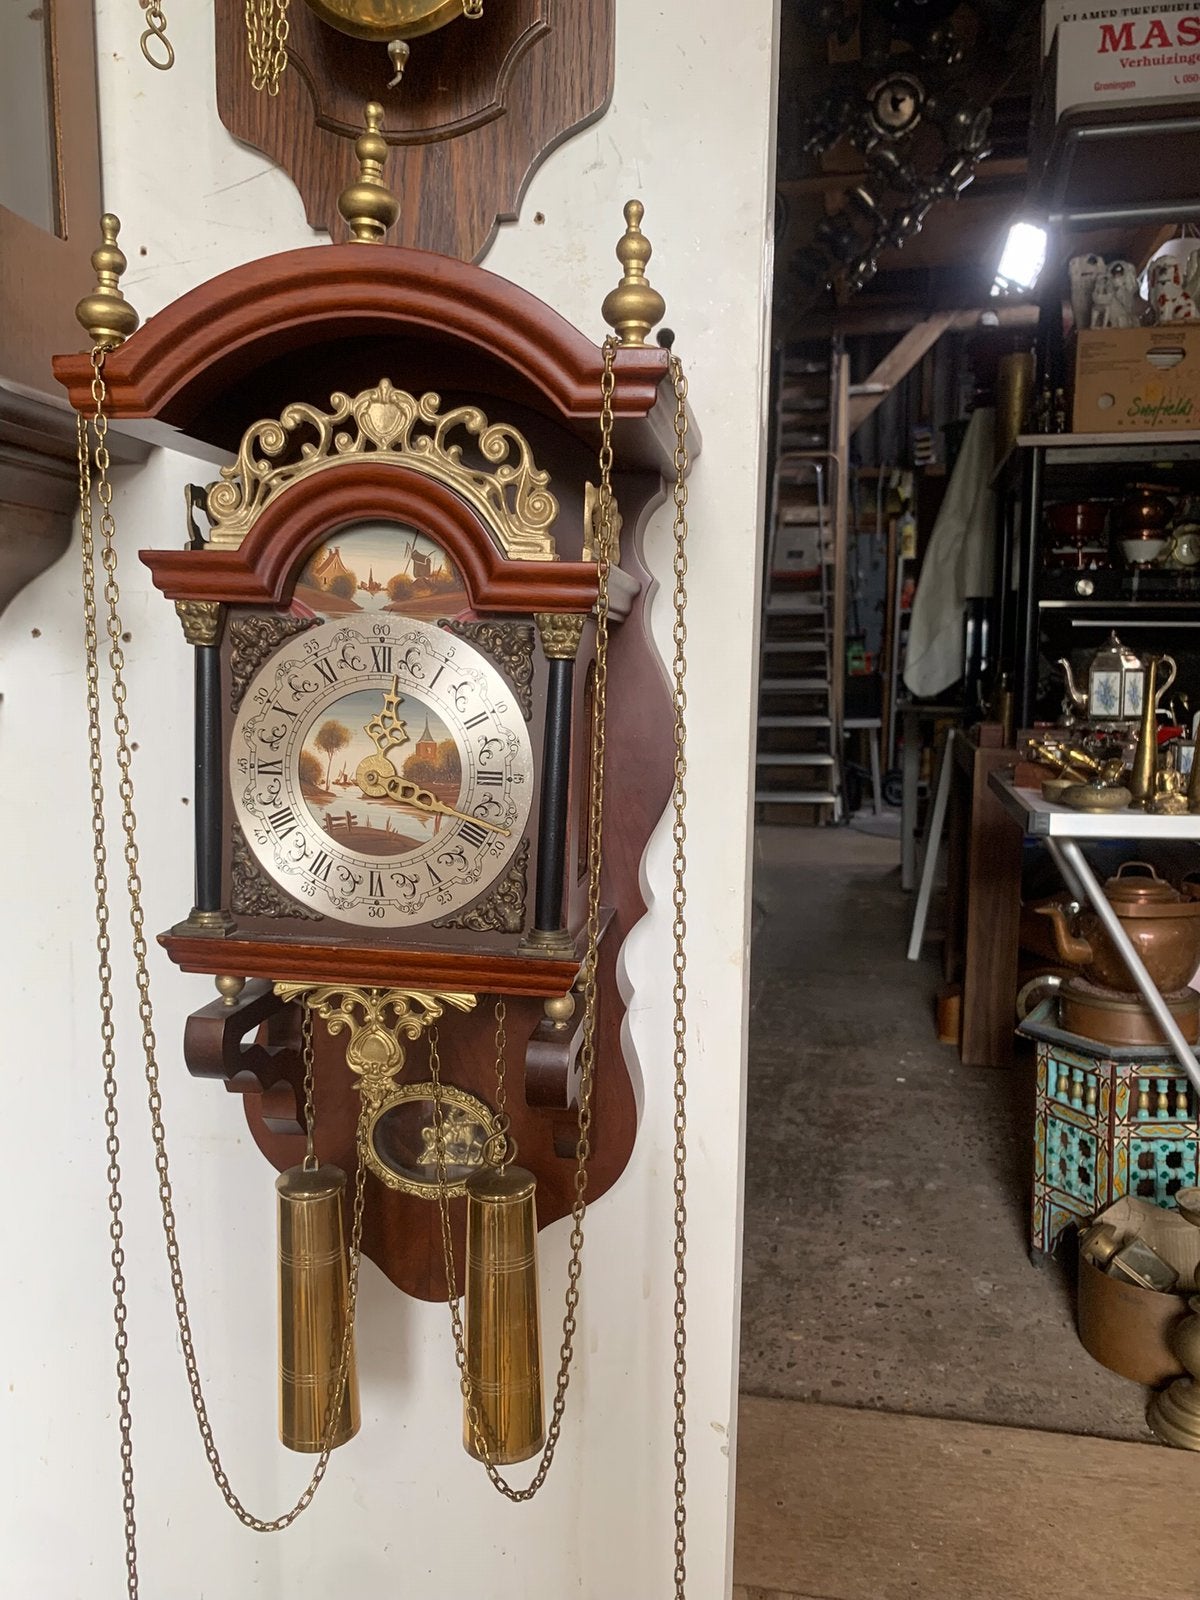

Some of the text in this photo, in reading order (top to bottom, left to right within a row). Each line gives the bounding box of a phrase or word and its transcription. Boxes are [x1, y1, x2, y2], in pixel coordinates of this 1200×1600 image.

[1097, 16, 1200, 53] MAS
[1094, 80, 1136, 91] Groningen
[372, 623, 391, 636] 60
[303, 638, 320, 654] 55
[446, 646, 457, 658] 5
[370, 646, 393, 673] XII
[313, 657, 339, 688] XI
[428, 665, 446, 689] I
[253, 687, 269, 705] 50
[271, 700, 299, 722] X
[494, 700, 508, 714] 10
[463, 711, 490, 730] II
[237, 757, 248, 775] 45
[257, 758, 283, 775] IX
[477, 770, 503, 786] III
[513, 772, 524, 784] 15
[267, 806, 299, 841] VIII
[253, 828, 268, 846] 40
[489, 840, 506, 859] 20
[309, 850, 335, 882] VII
[425, 861, 444, 887] V
[300, 881, 317, 897] 35
[369, 870, 386, 898] VI
[436, 890, 453, 906] 25
[368, 906, 386, 918] 30
